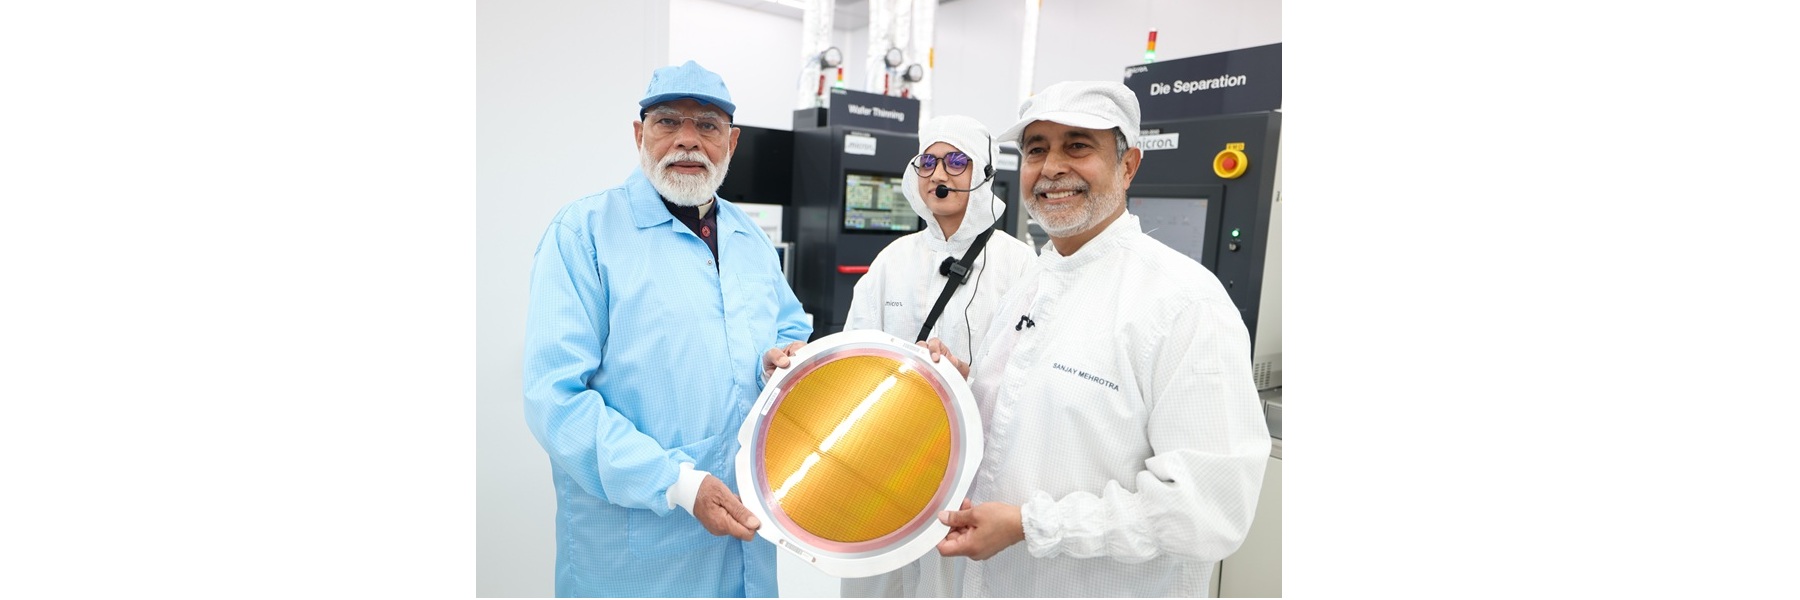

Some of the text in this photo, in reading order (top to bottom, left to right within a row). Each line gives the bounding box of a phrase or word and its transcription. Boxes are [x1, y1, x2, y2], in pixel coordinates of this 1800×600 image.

[1150, 74, 1247, 96] Die Separation
[848, 104, 905, 122] Wafer Thinning
[1053, 363, 1119, 391] SANJAY MEHROTRA
